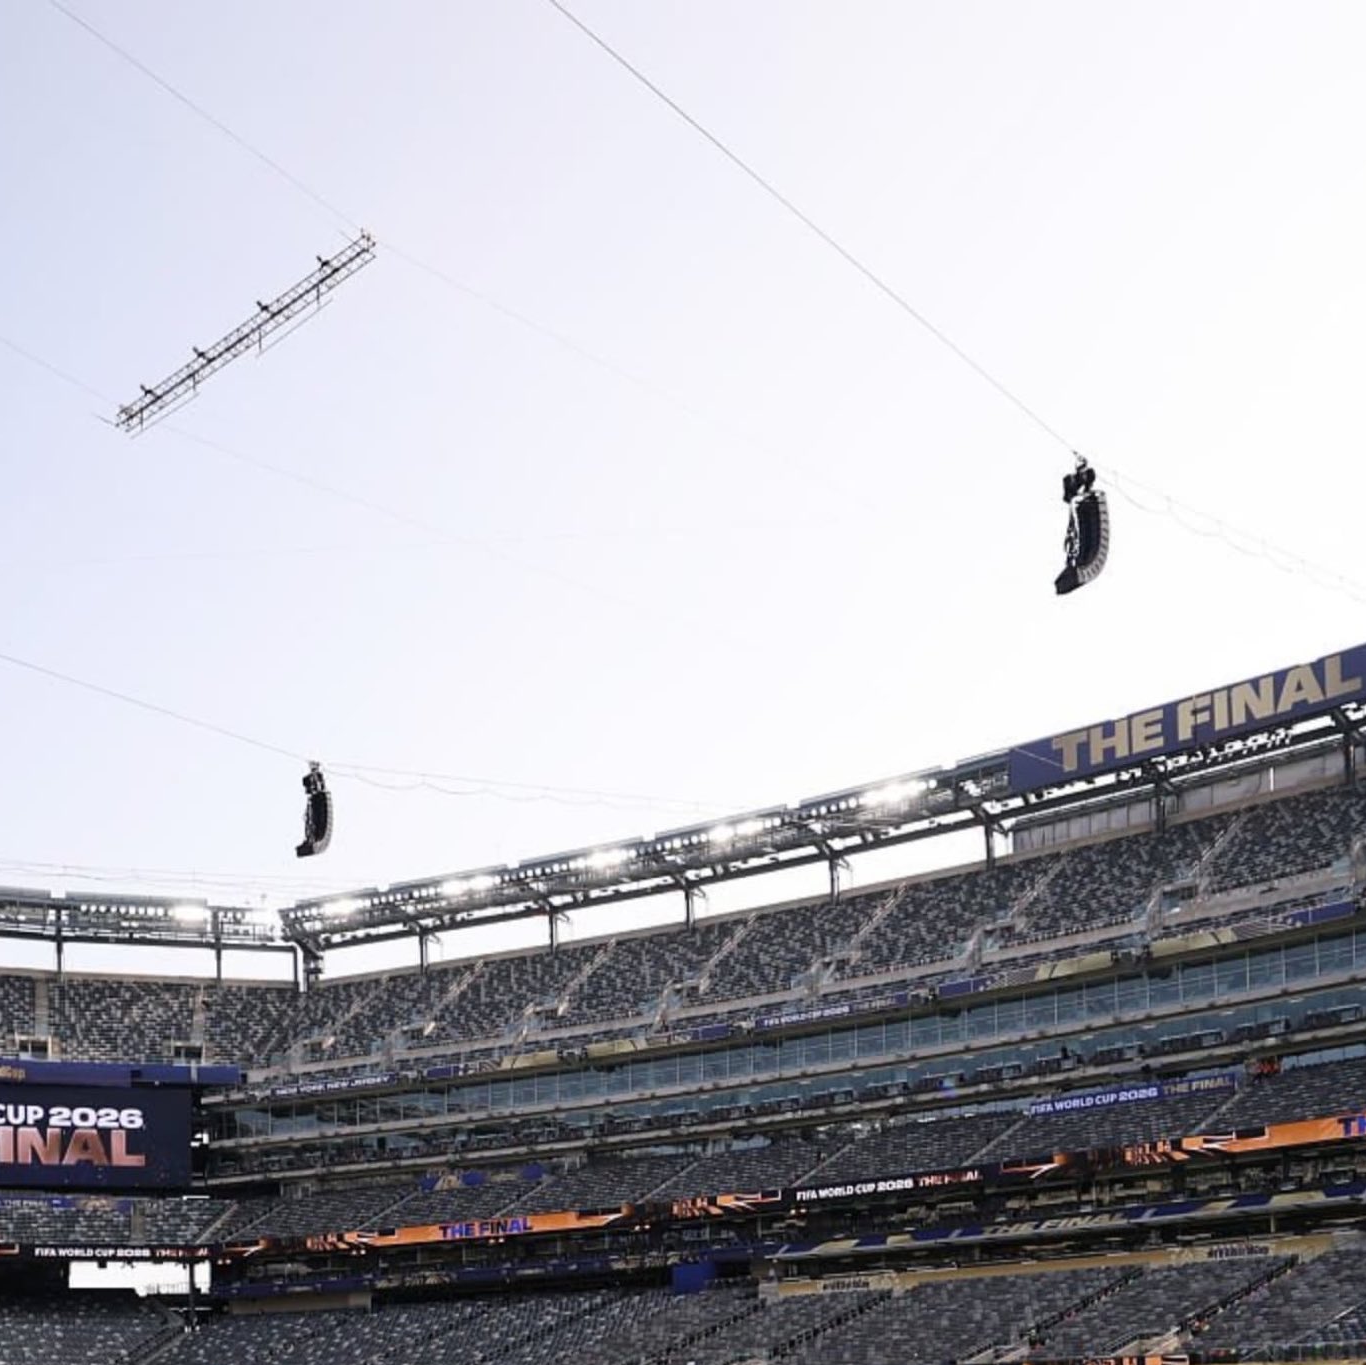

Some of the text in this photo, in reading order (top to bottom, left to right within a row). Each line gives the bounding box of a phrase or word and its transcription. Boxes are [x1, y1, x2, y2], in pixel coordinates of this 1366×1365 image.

[1052, 654, 1362, 773] THE FINAL
[1030, 1103, 1054, 1114] FIFA
[1054, 1096, 1094, 1110] WORLD
[1095, 1093, 1118, 1105] CUP
[1118, 1087, 1159, 1101] 2026
[1163, 1083, 1190, 1095] THE
[49, 1107, 144, 1129] 2026
[796, 1190, 817, 1201] FIFA
[819, 1185, 854, 1198] WORLD
[855, 1182, 876, 1194] CUP
[877, 1178, 914, 1192] 2026
[944, 1170, 983, 1184] FAL
[439, 1217, 533, 1238] THE FINAL
[1039, 1212, 1124, 1230] FINAL
[35, 1248, 56, 1257] FIFA
[58, 1248, 93, 1257] WORLD
[95, 1248, 115, 1257] CUP
[116, 1248, 150, 1257] 2026
